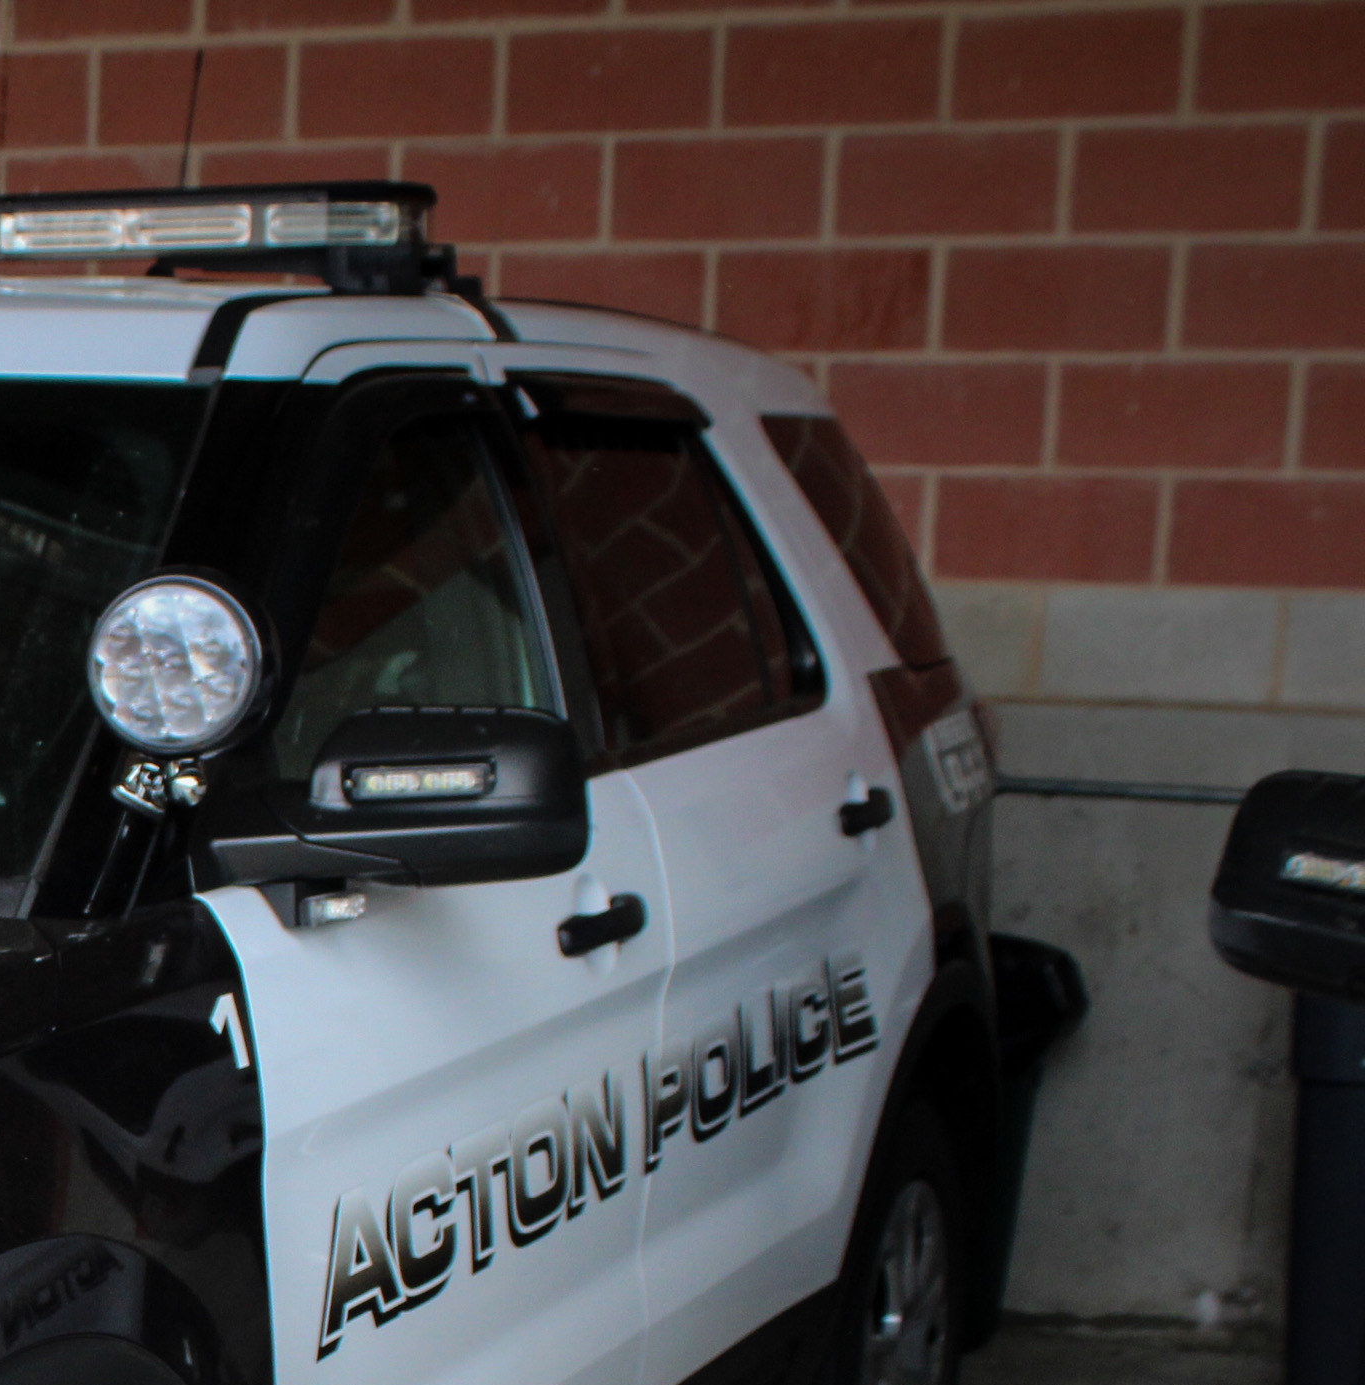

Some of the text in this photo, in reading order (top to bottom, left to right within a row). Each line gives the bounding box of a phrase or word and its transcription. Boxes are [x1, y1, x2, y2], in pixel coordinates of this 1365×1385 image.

[209, 992, 250, 1070] 1
[315, 950, 880, 1364] ACTON POLICE
